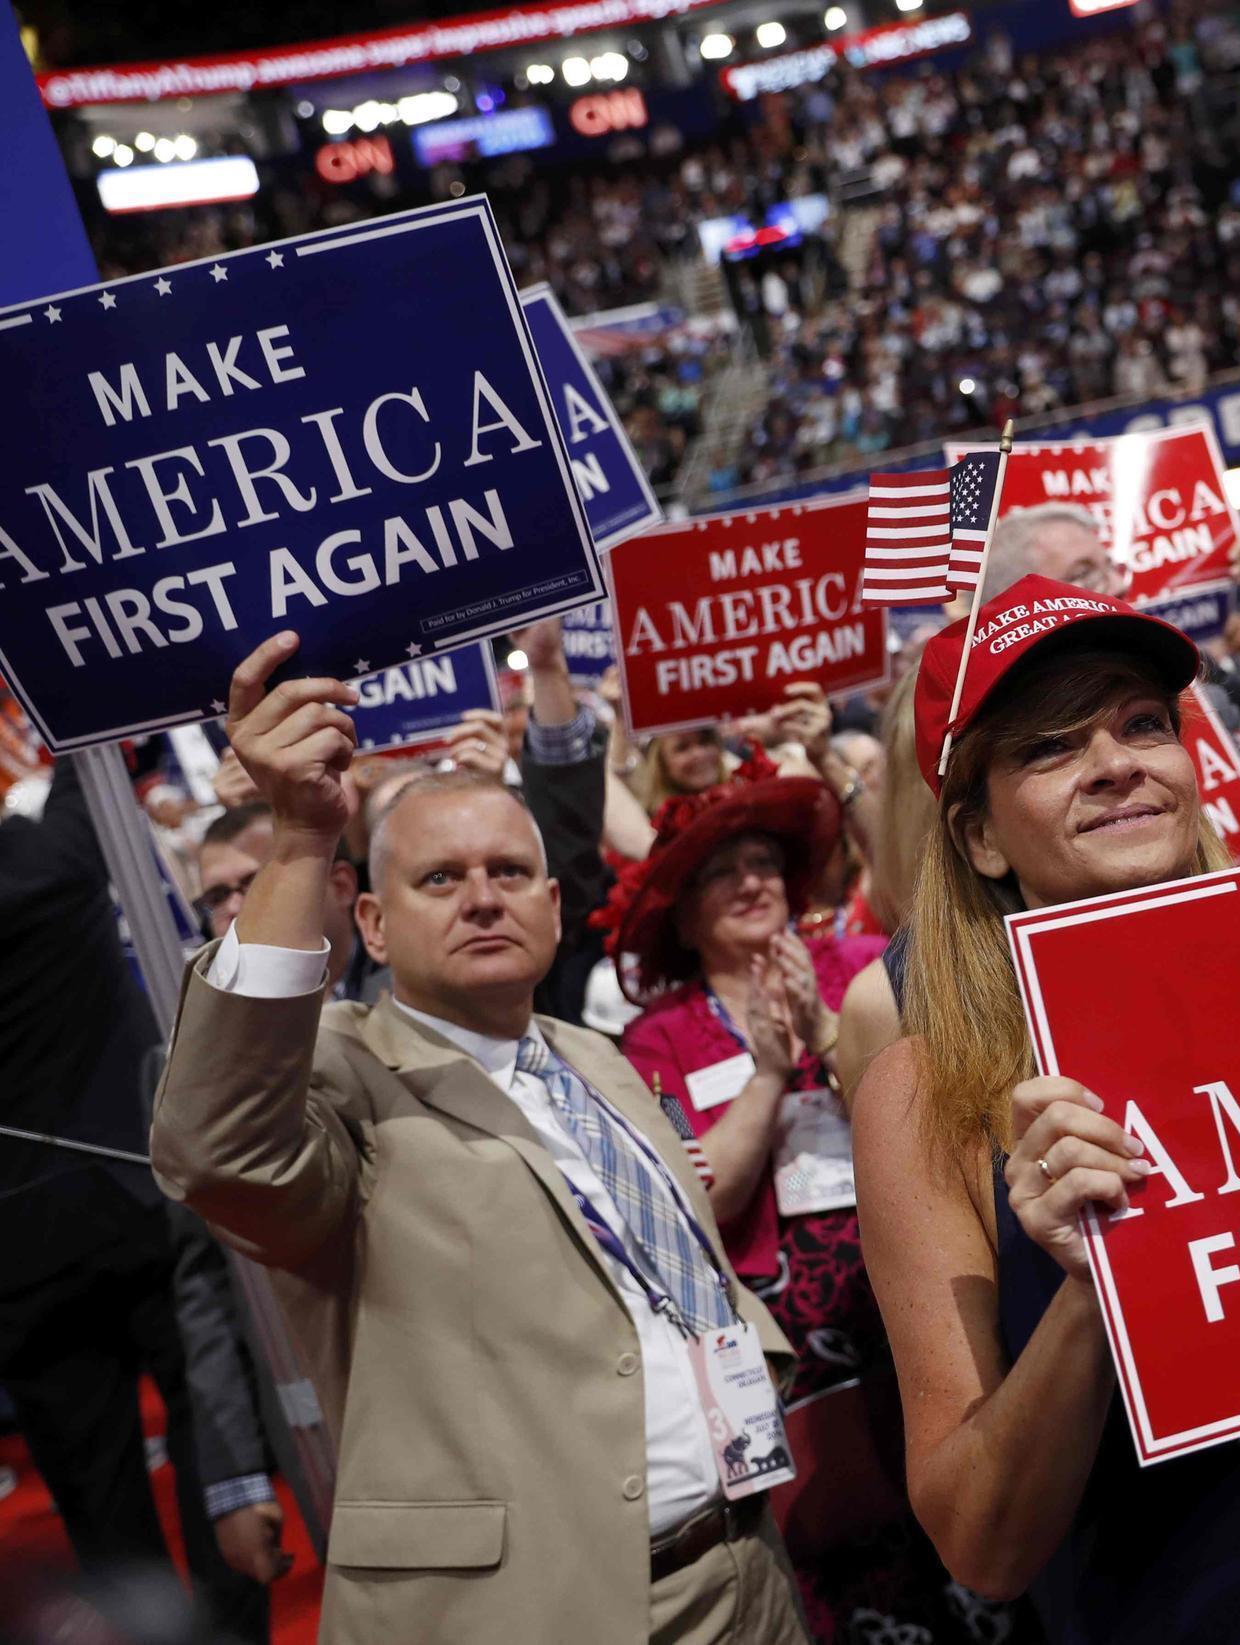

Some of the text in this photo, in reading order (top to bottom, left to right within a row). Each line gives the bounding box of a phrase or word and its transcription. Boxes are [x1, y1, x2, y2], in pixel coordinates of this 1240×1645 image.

[87, 324, 306, 427] MAKE
[1041, 467, 1113, 497] MAK
[709, 538, 804, 582] MAKE
[1126, 523, 1215, 573] GAIN
[45, 489, 515, 668] FIRST AGAIN
[627, 567, 866, 656] AMERIC
[971, 604, 1030, 648] MAKE
[989, 616, 1058, 655] GREAT
[343, 655, 458, 711] GAIN
[656, 645, 757, 695] FIRST
[765, 623, 865, 677] AGAIN
[707, 1407, 729, 1441] 3
